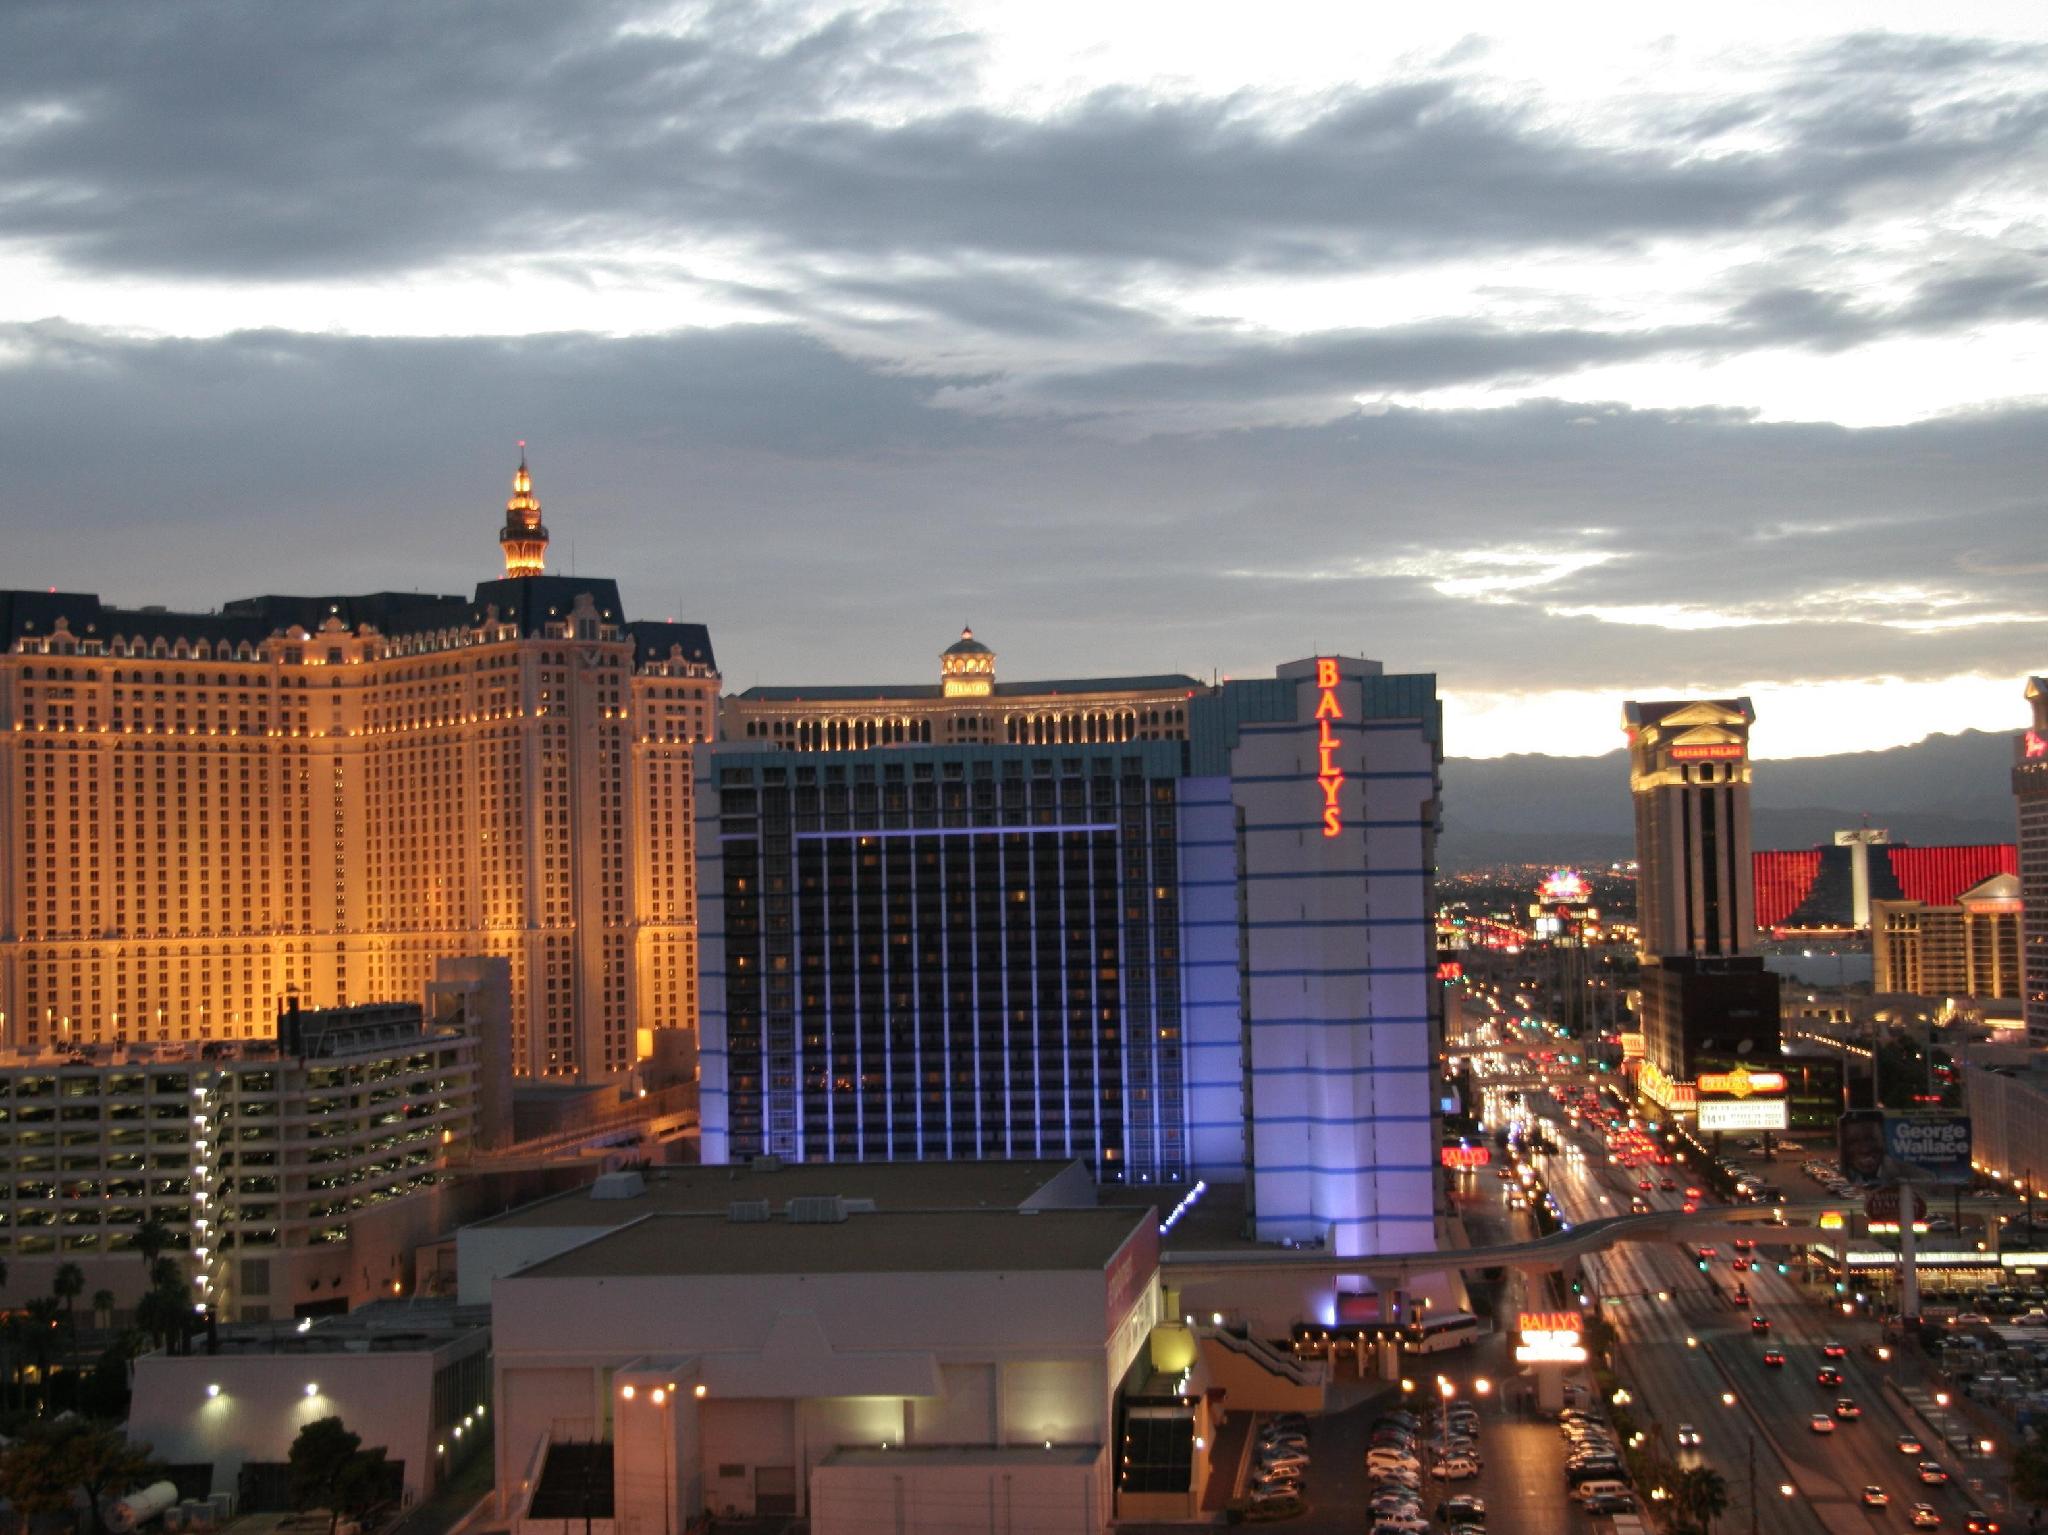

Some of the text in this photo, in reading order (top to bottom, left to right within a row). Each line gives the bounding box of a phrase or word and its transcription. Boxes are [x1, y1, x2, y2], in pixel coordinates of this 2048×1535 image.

[1316, 659, 1342, 836] BALLYS
[1896, 1123, 1966, 1141] George
[1893, 1138, 1968, 1153] Wallace
[1520, 1313, 1580, 1331] BALLYS
